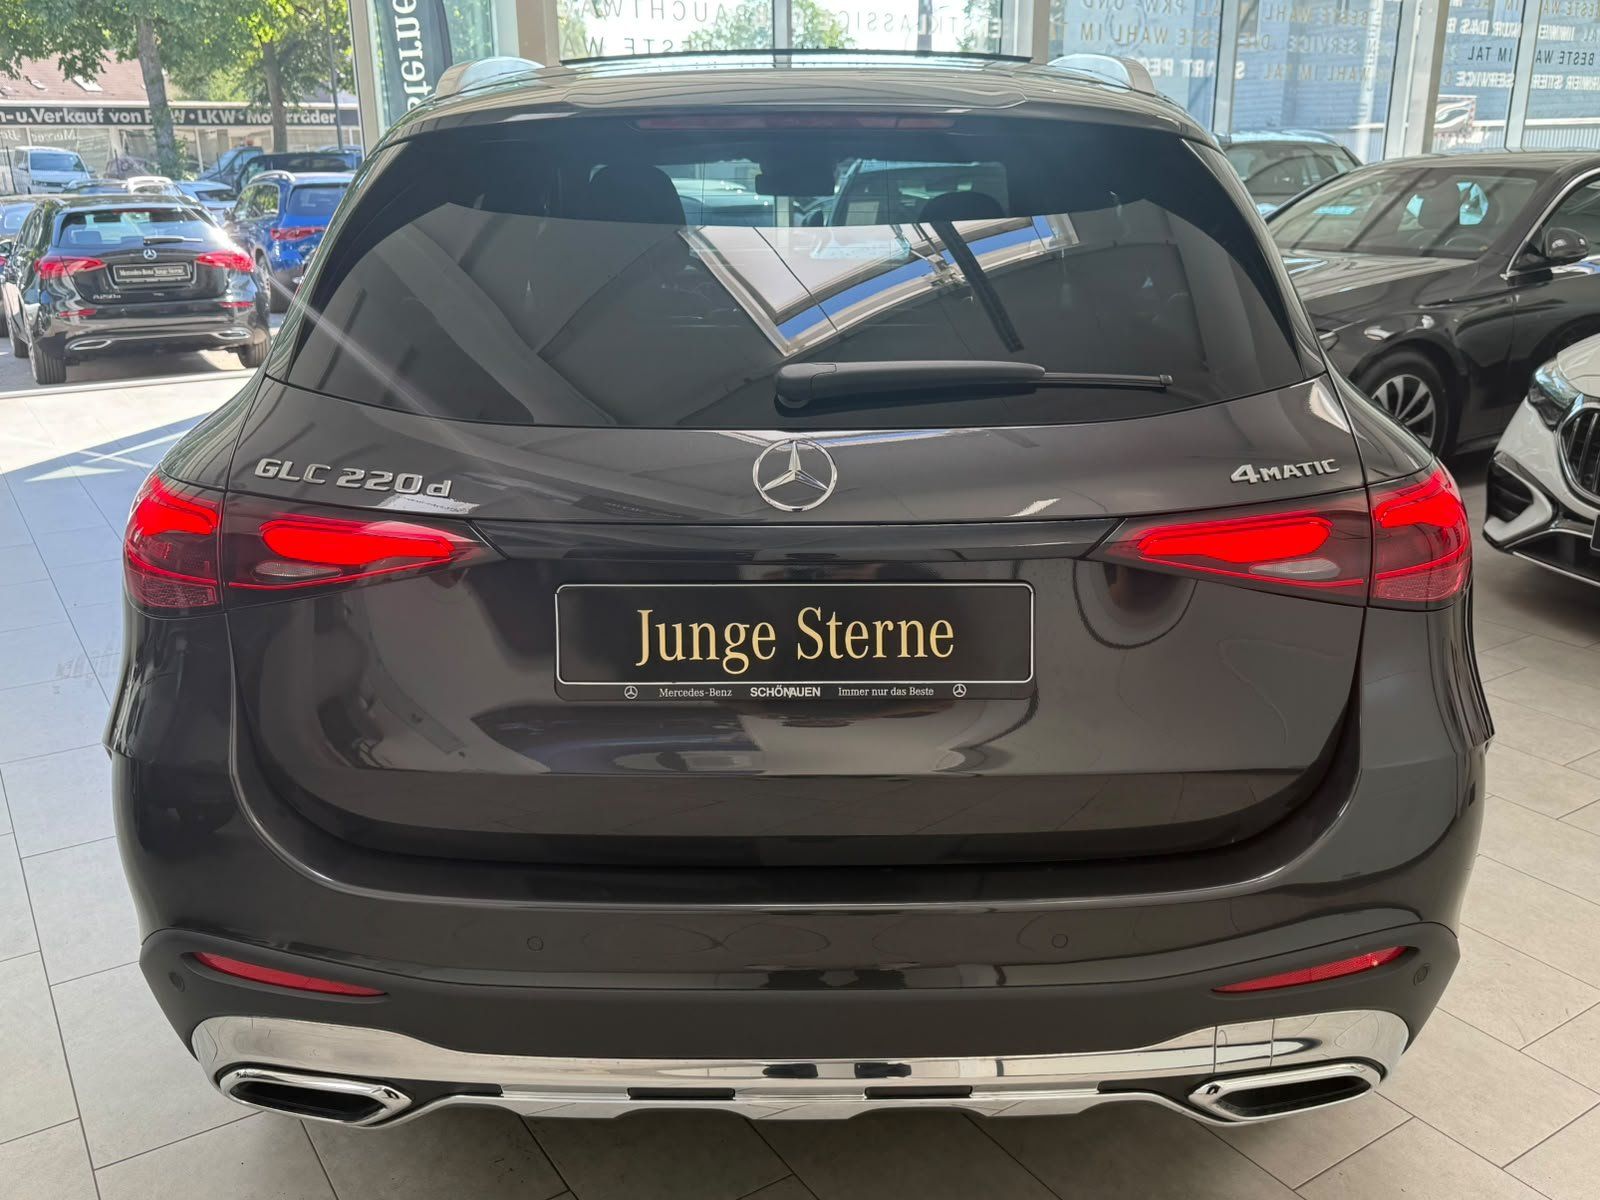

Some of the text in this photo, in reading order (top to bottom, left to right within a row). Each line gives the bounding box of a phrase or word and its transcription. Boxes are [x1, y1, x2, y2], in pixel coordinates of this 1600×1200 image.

[110, 112, 142, 124] von
[197, 109, 236, 125] LKW
[254, 457, 331, 485] GLC
[1230, 459, 1340, 484] 4MATIC
[635, 606, 954, 675] Junge Sterne
[658, 684, 935, 698] Mercedes-Benz SCHÖNAUEN Immer nur das Beste
